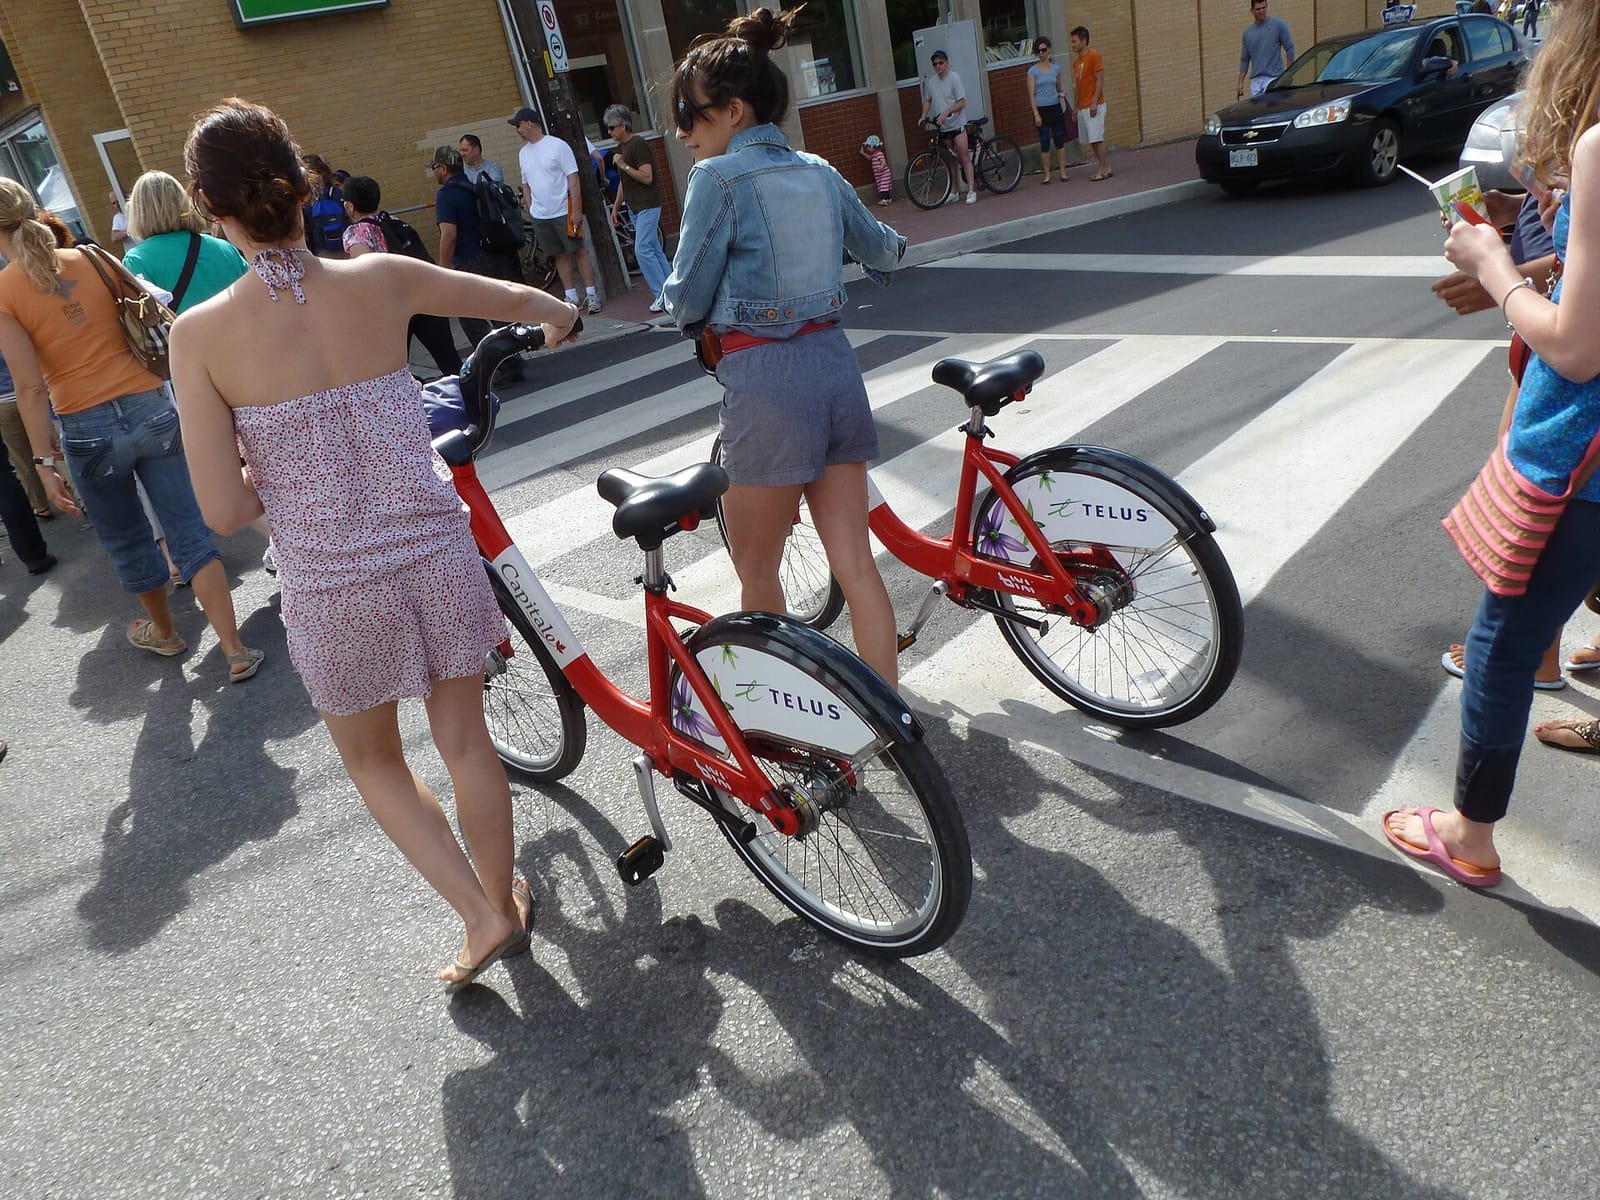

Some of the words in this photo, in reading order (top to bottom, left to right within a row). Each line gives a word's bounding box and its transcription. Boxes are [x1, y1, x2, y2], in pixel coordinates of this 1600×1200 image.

[1082, 503, 1148, 522] TELUS
[501, 563, 556, 647] Capitale
[769, 688, 841, 720] TELUS
